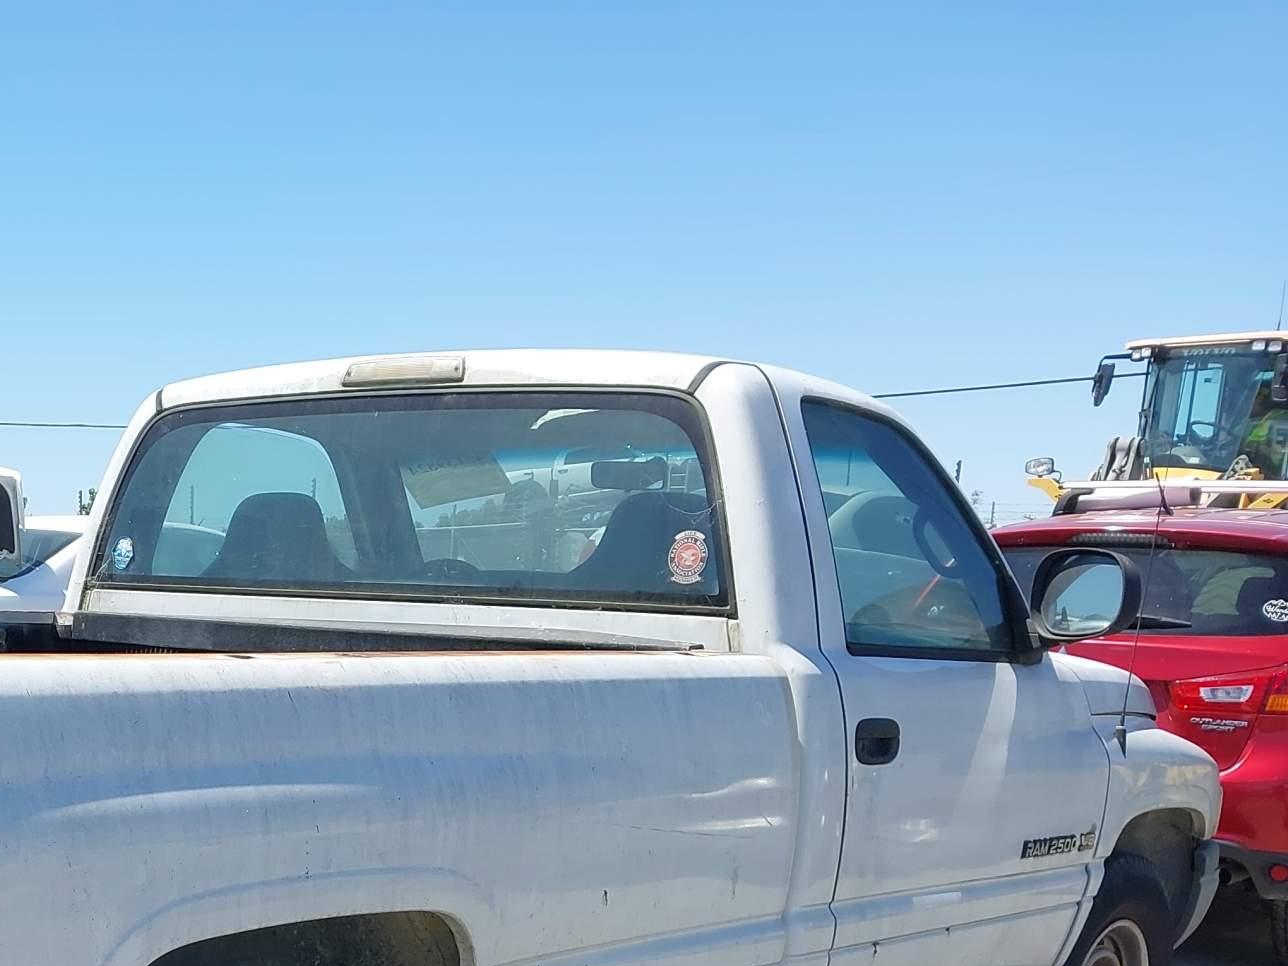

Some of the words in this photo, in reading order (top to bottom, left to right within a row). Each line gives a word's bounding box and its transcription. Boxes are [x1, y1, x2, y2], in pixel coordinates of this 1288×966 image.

[670, 537, 696, 558] NATIONAL
[1023, 839, 1050, 858] RAM
[1049, 837, 1078, 855] 2500
